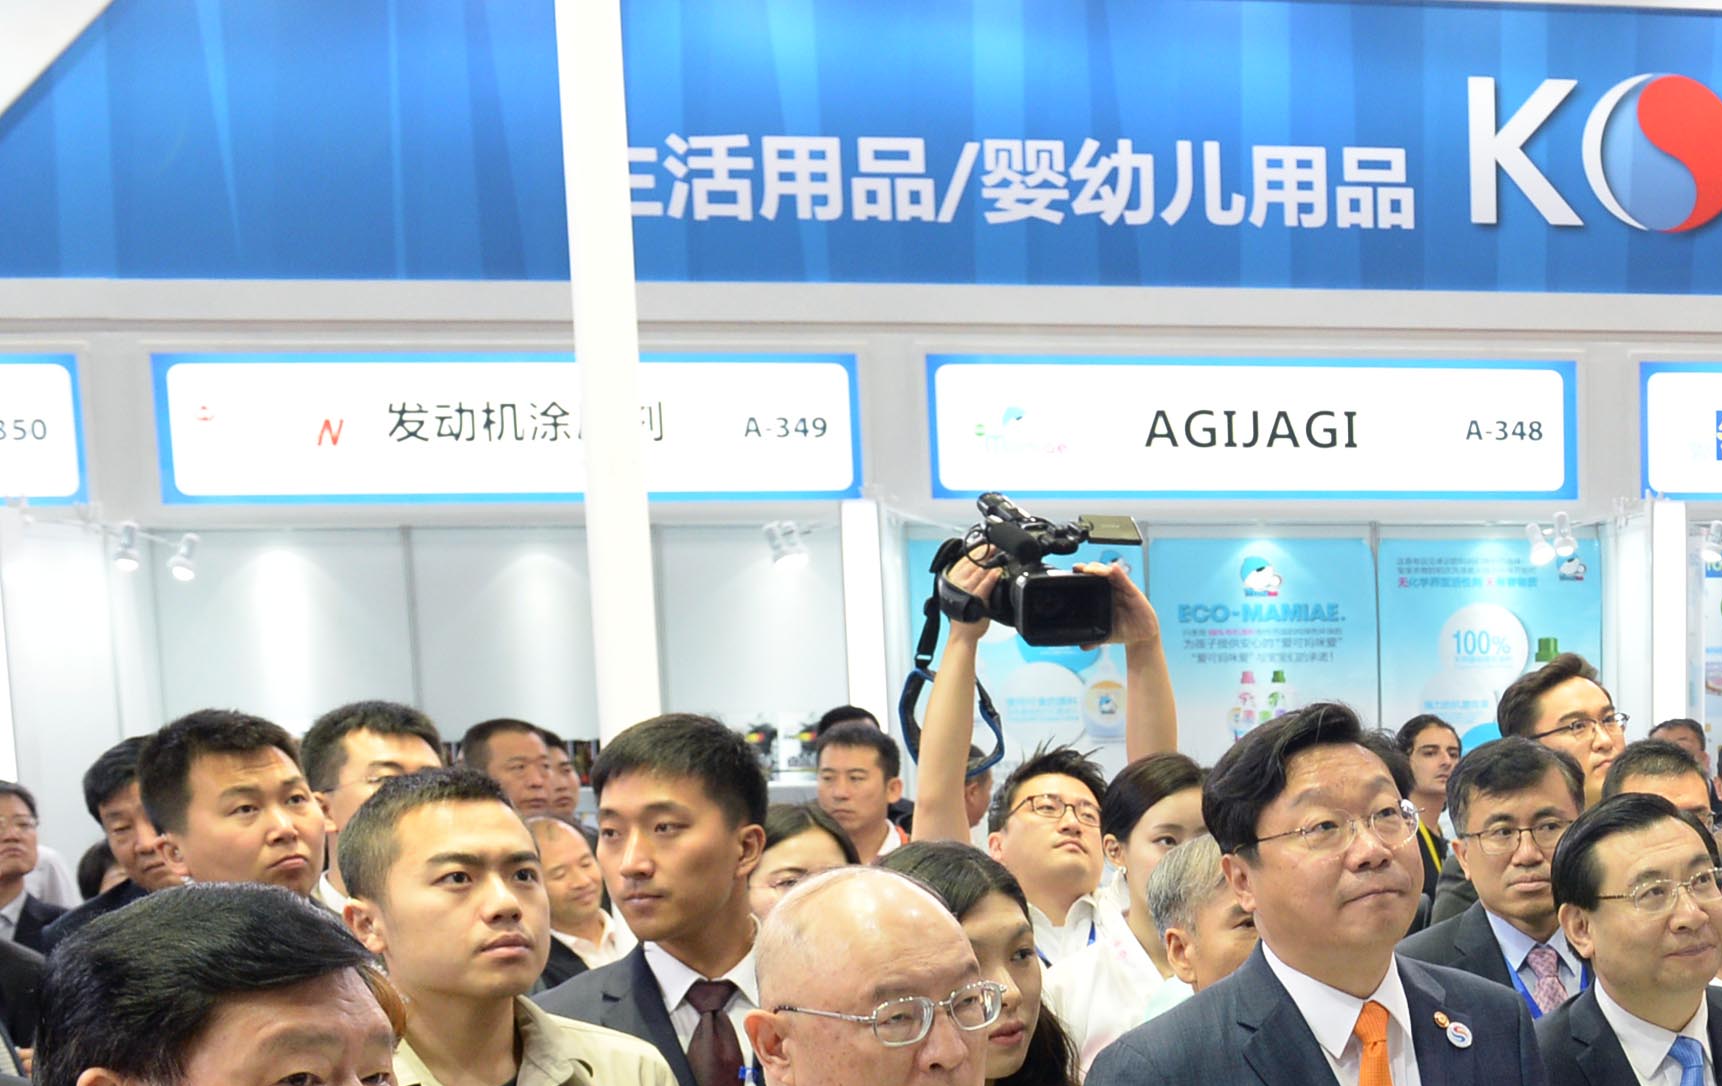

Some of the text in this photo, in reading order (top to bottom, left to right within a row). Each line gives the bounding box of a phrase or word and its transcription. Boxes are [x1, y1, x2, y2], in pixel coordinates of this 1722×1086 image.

[744, 414, 829, 439] A-349
[1145, 409, 1359, 450] AGIJAGI
[1465, 419, 1544, 442] A-348
[1453, 630, 1512, 655] 100%
